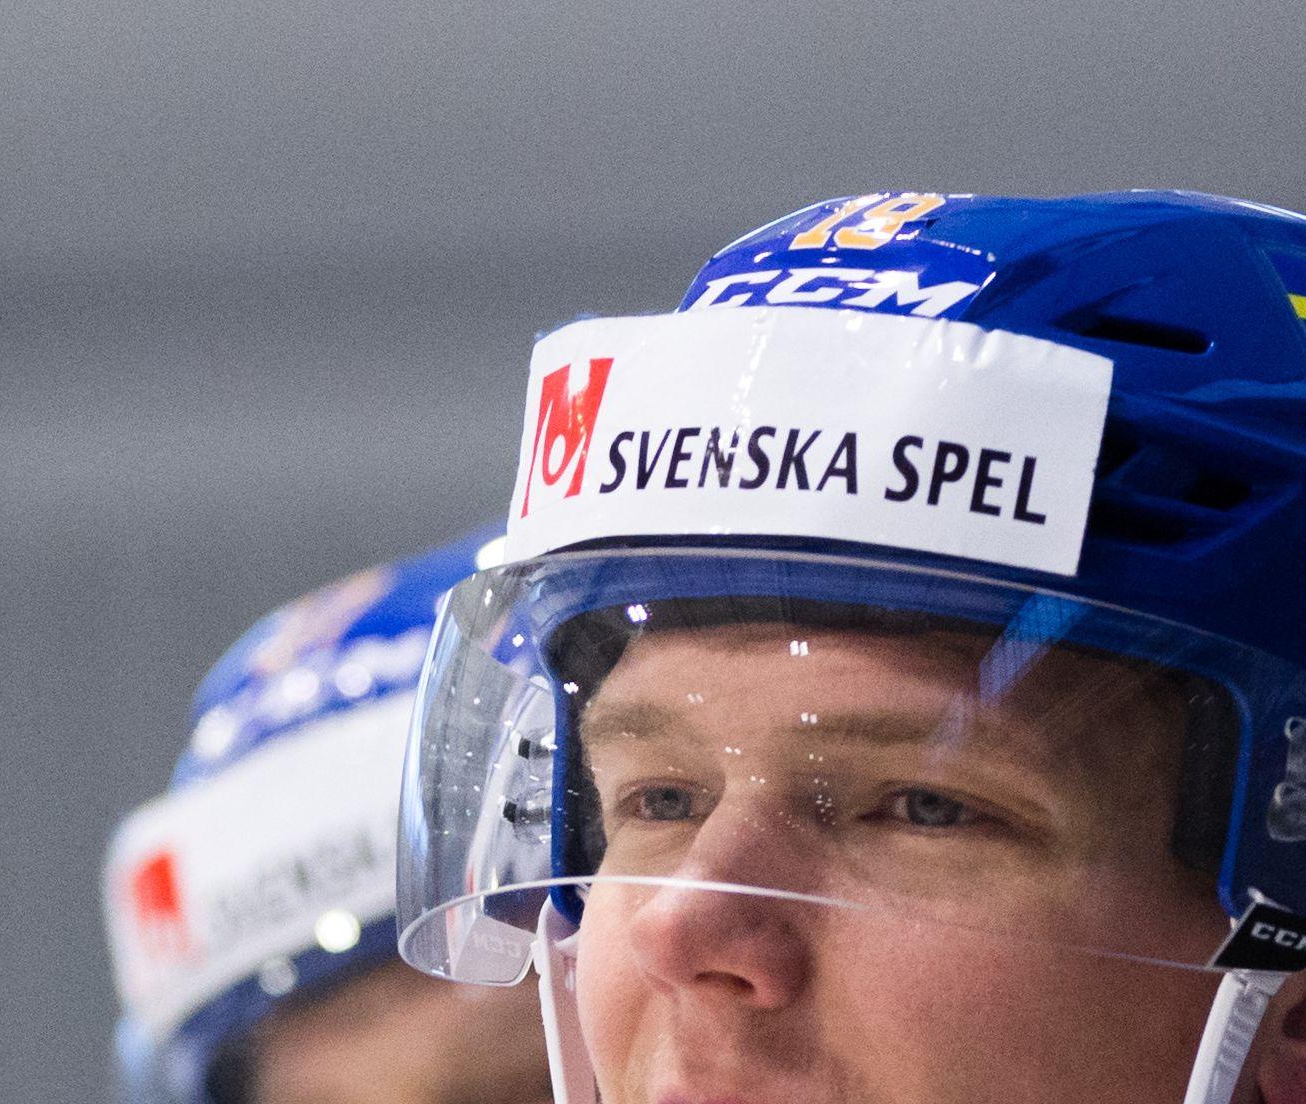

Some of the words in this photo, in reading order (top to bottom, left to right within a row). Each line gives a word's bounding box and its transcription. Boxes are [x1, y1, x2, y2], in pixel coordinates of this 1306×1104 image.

[685, 267, 981, 318] CCM
[598, 426, 859, 495] SVENSKA
[884, 434, 1048, 526] SPEL
